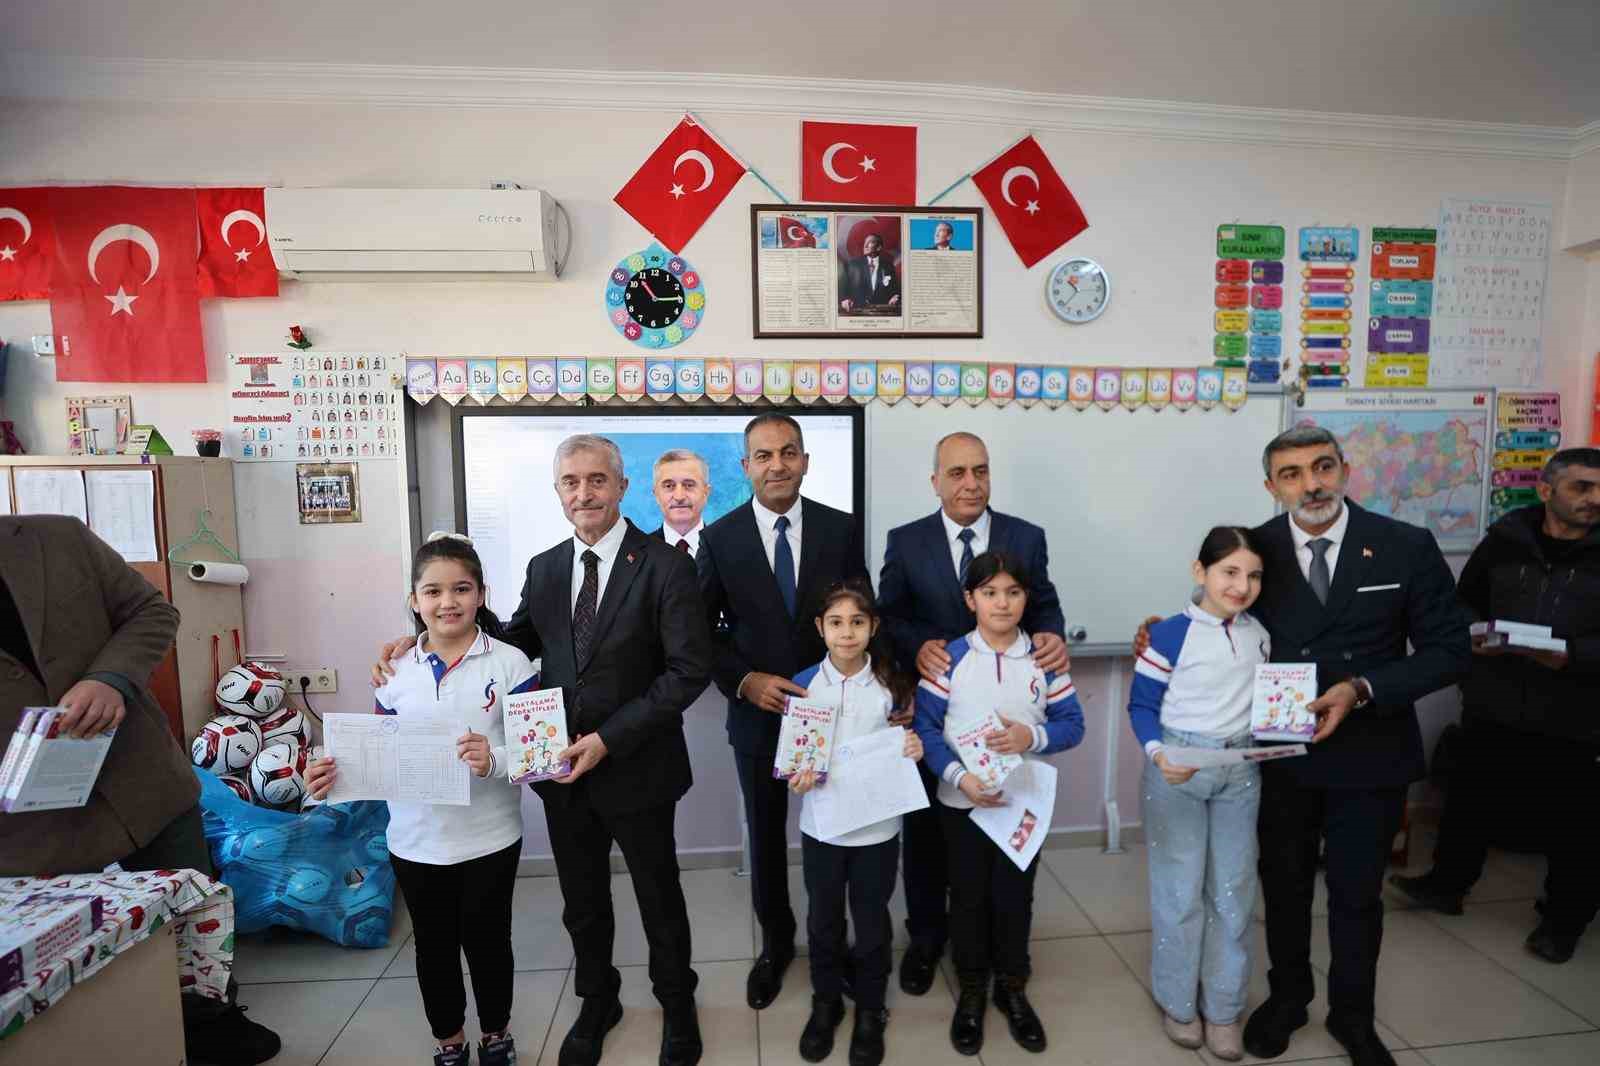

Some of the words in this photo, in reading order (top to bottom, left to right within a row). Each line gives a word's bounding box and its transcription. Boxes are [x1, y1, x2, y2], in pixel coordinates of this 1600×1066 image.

[651, 269, 660, 277] 12
[626, 292, 631, 300] 9
[650, 319, 656, 327] 6
[443, 370, 462, 384] Aa
[474, 370, 491, 383] Bb
[503, 370, 521, 383] Cc
[562, 369, 581, 383] Dd
[593, 370, 610, 383] Ee
[624, 370, 639, 383] Ff
[649, 368, 670, 386] Gg
[710, 371, 728, 384] Hh
[800, 371, 813, 389] Jj
[827, 372, 842, 385] Kk
[856, 372, 869, 385] Ll
[880, 373, 902, 384] Mm
[909, 373, 928, 385] Nn
[937, 373, 956, 386] Oo
[1021, 375, 1035, 388] Rr
[995, 374, 1009, 392] Pp
[1048, 376, 1061, 390] Ss
[1101, 378, 1114, 392] Tt
[1178, 380, 1193, 392] Vv
[1201, 380, 1216, 396] Yy
[1227, 379, 1241, 393] Zz
